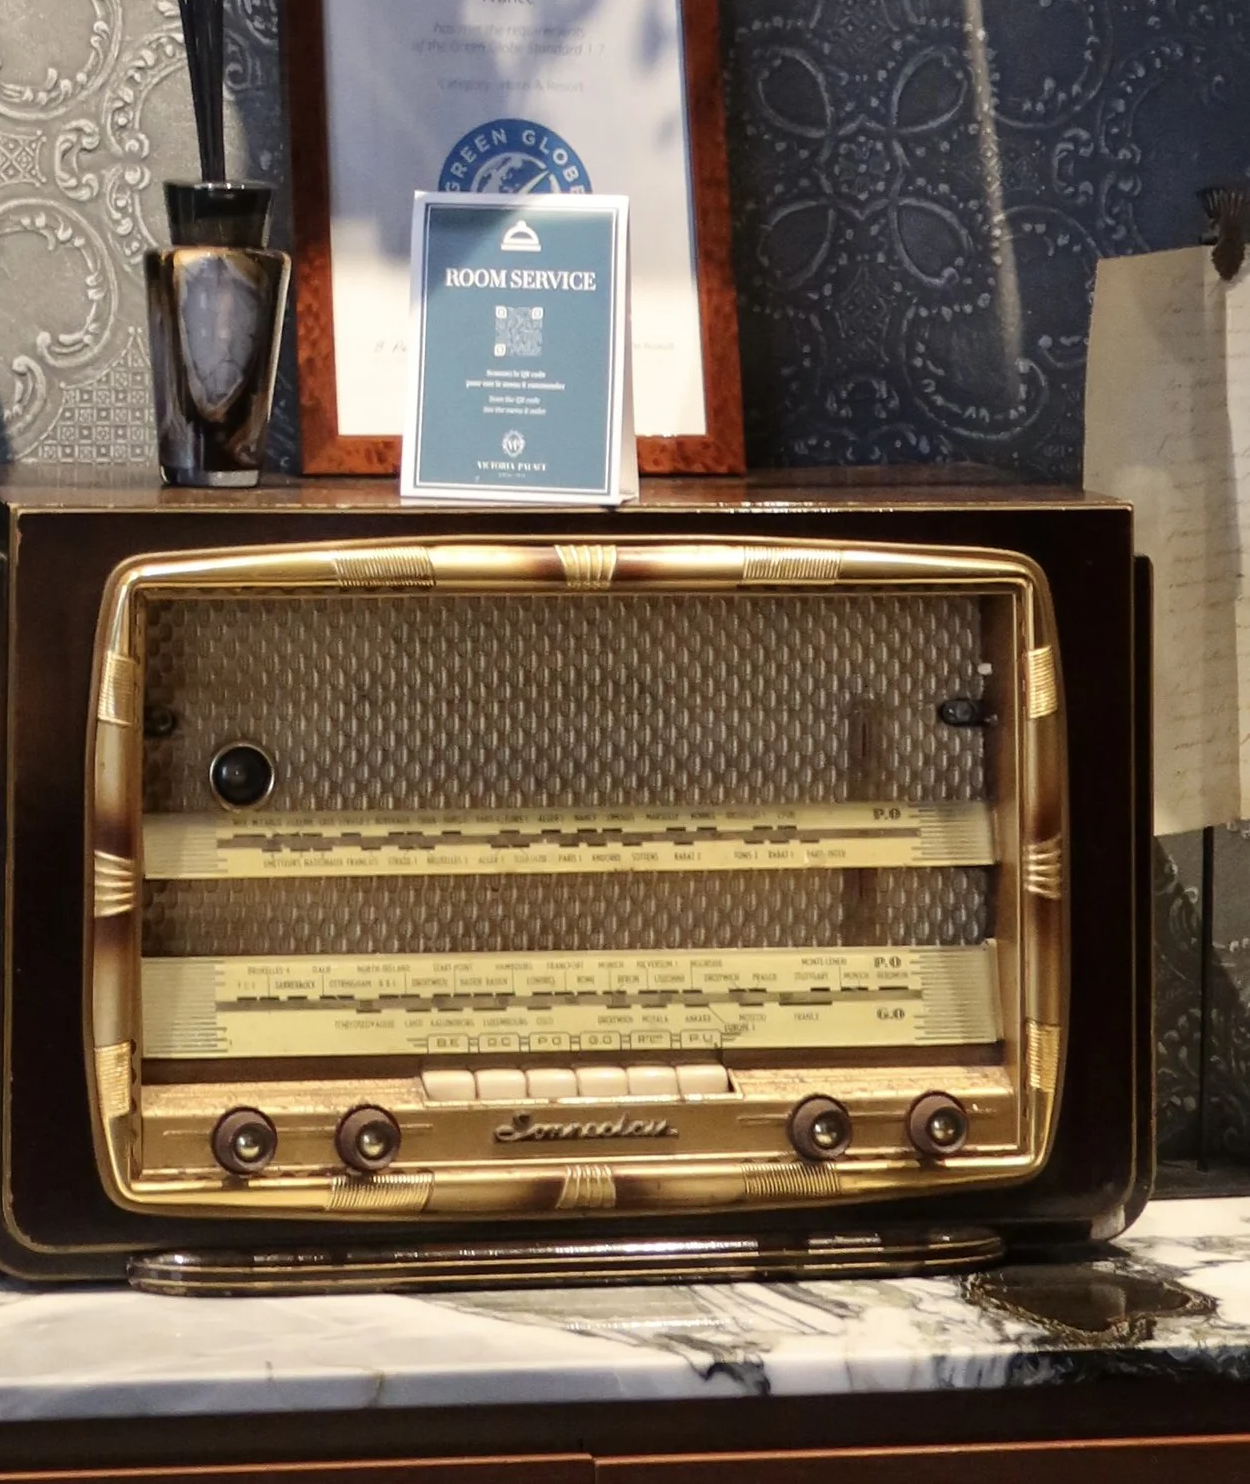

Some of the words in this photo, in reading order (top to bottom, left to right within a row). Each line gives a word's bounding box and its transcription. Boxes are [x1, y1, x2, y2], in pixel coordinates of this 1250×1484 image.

[527, 43, 583, 56] Standard
[444, 128, 508, 193] GREEN
[445, 267, 507, 289] ROOM
[510, 269, 597, 291] SERVICE
[476, 460, 515, 470] VICTORIA
[517, 461, 547, 471] PALACE
[873, 956, 902, 969] P.O
[876, 1007, 906, 1021] G.O
[537, 1035, 562, 1046] P.O
[588, 1034, 613, 1045] G.O
